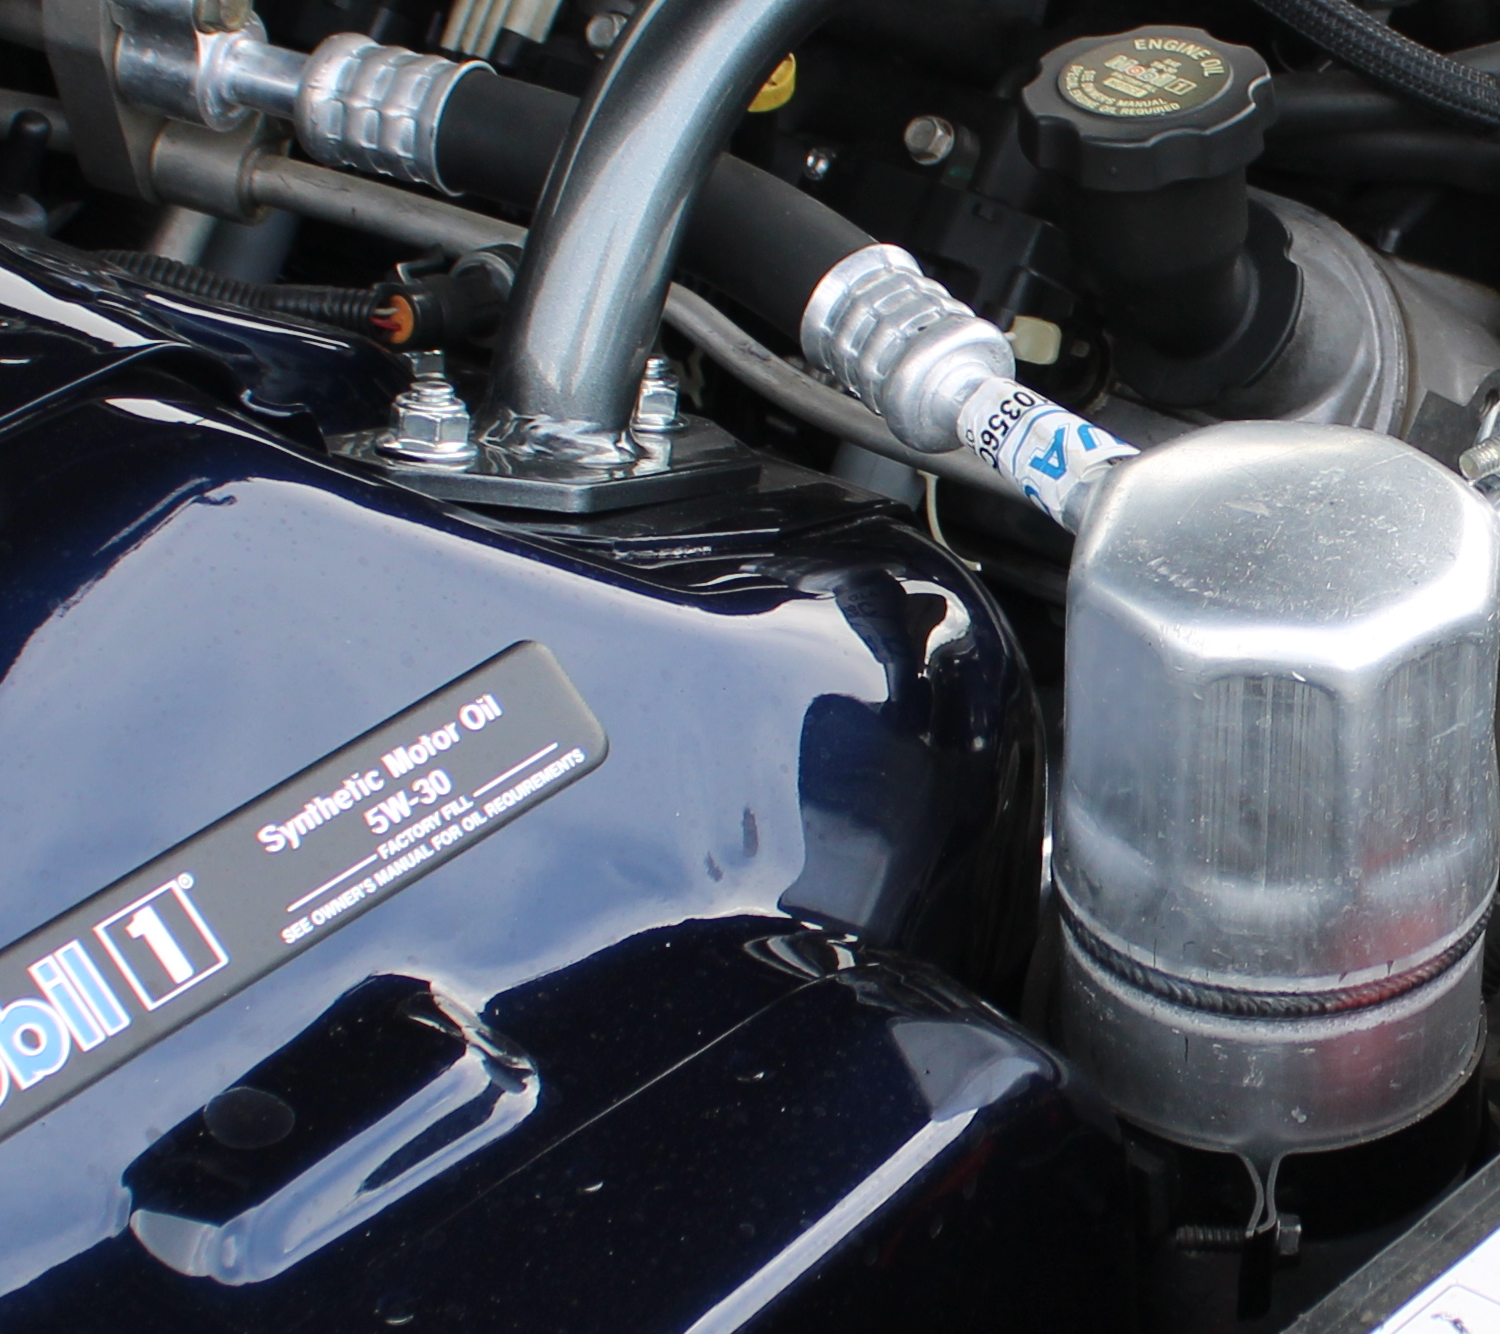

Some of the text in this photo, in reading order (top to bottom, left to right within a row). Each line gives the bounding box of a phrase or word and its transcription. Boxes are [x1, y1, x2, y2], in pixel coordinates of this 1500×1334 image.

[1134, 38, 1211, 60] ENGINE
[1201, 59, 1225, 78] OIL
[1115, 98, 1168, 108] MANUAL
[1119, 102, 1181, 116] REQUIRED
[256, 694, 503, 852] Synthetic Motor Oil
[363, 769, 451, 835] 5W-30
[281, 747, 585, 944] SEE OWNER'S MANUAL FOR OIL REQUIREMENTS
[376, 795, 474, 860] FACTORY FILL
